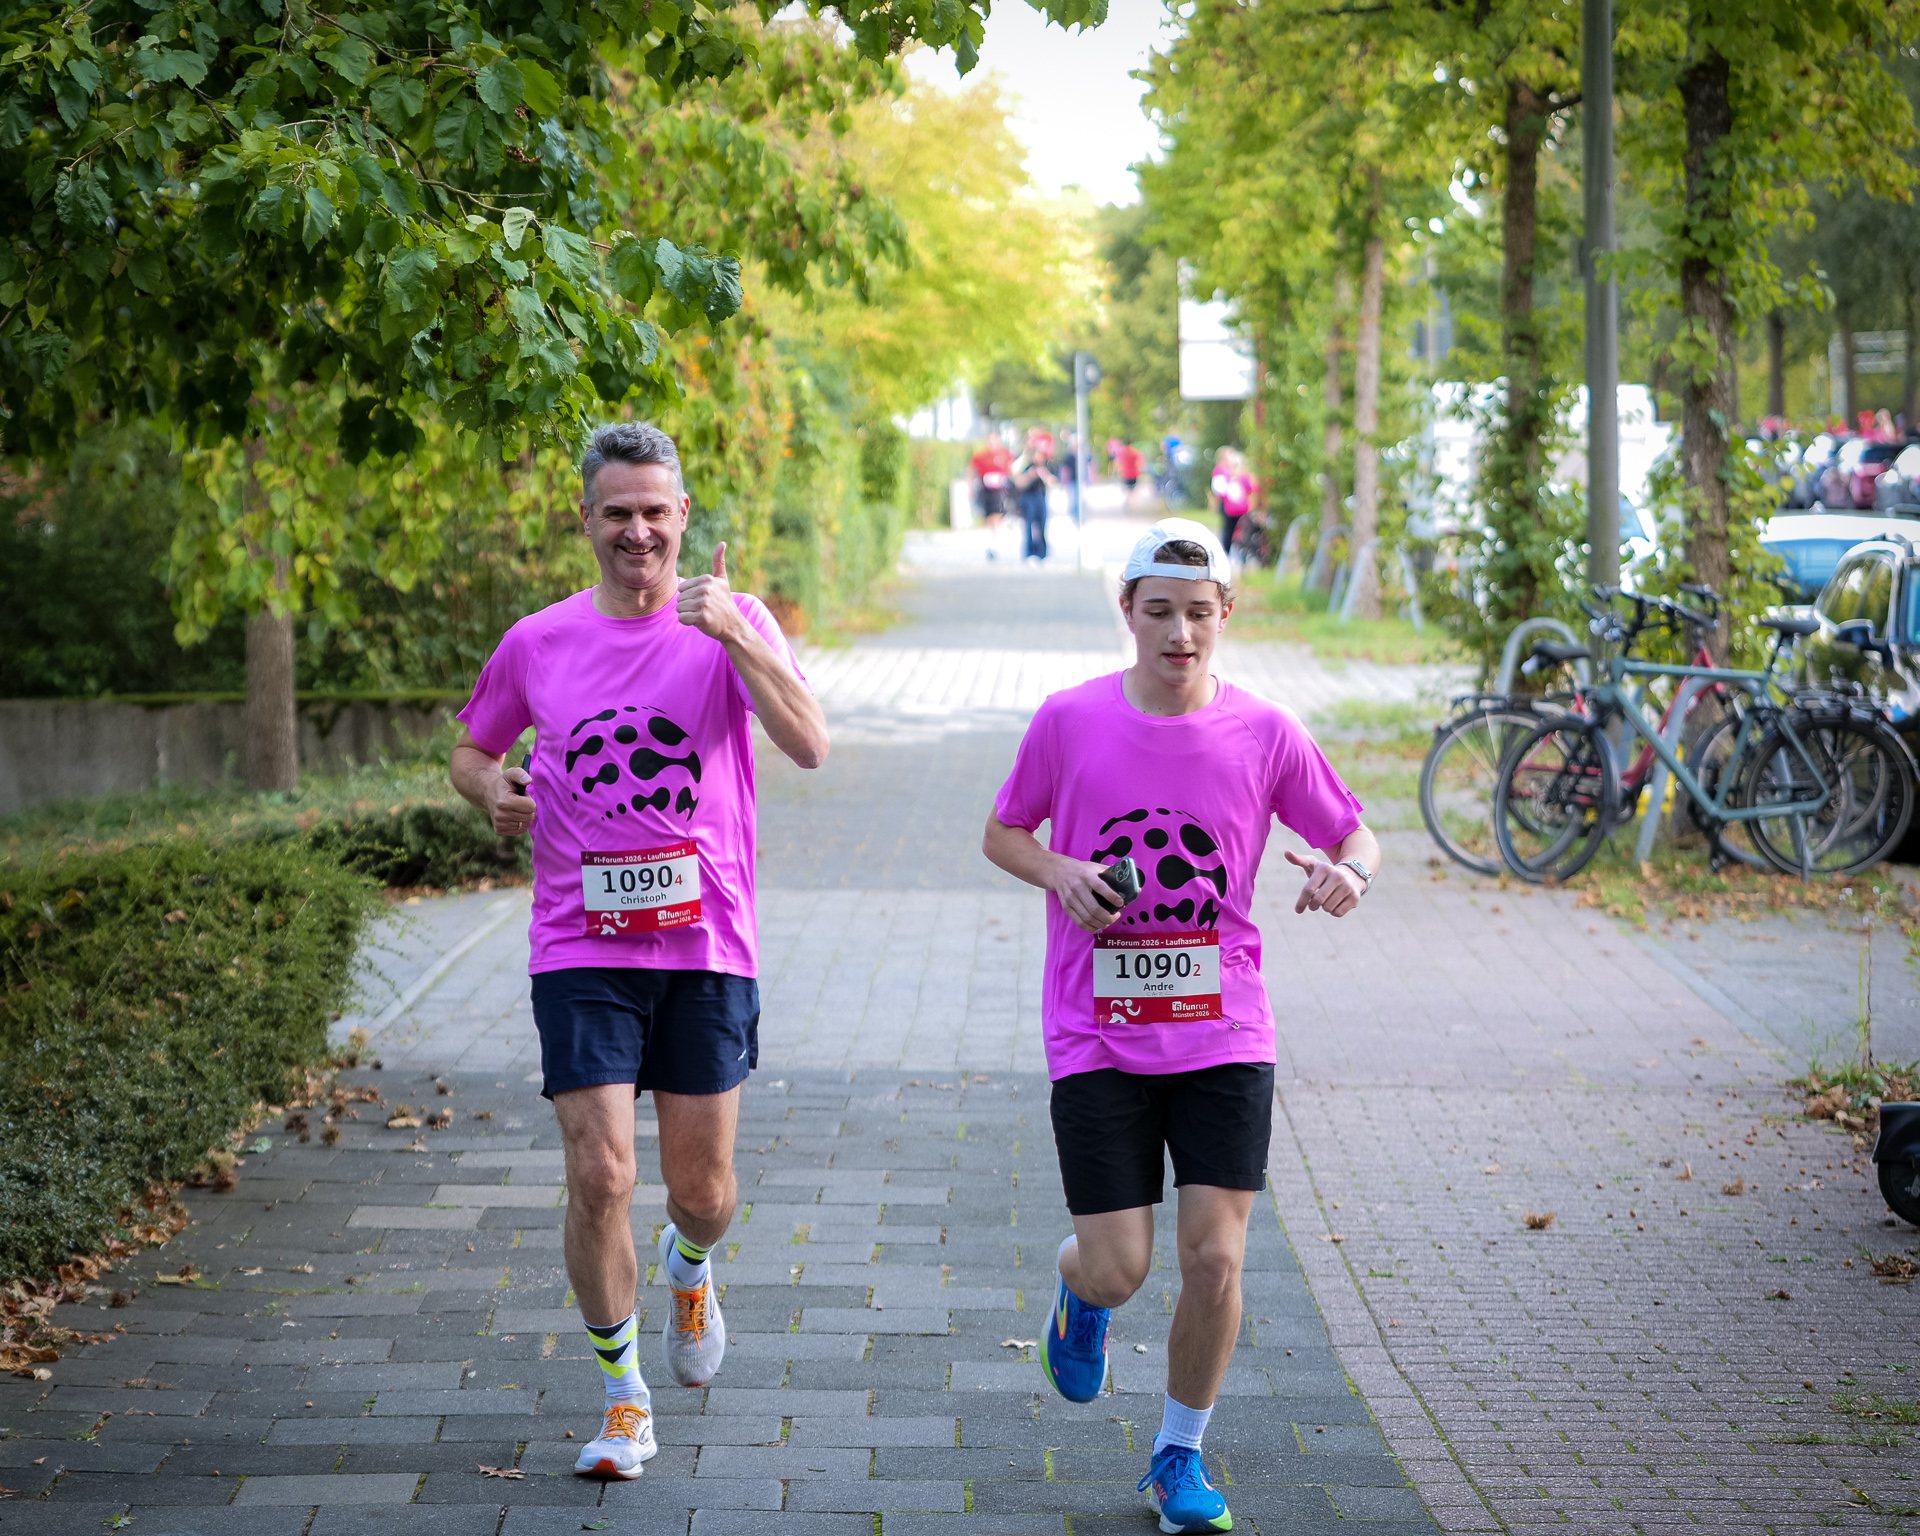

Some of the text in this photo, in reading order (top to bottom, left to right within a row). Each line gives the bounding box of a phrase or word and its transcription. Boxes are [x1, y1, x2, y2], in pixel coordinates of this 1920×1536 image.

[594, 856, 623, 864] FI-Forum
[624, 853, 642, 863] 2026
[647, 850, 681, 860] Laufhasen
[602, 865, 683, 893] 1090 4
[620, 892, 667, 904] Christoph
[679, 916, 691, 924] 2026
[1107, 939, 1140, 947] FI-Forum
[1165, 938, 1201, 946] Laufhasen
[1115, 952, 1201, 979] 1090 2
[1143, 982, 1174, 991] Andre
[1182, 1002, 1209, 1011] funrun
